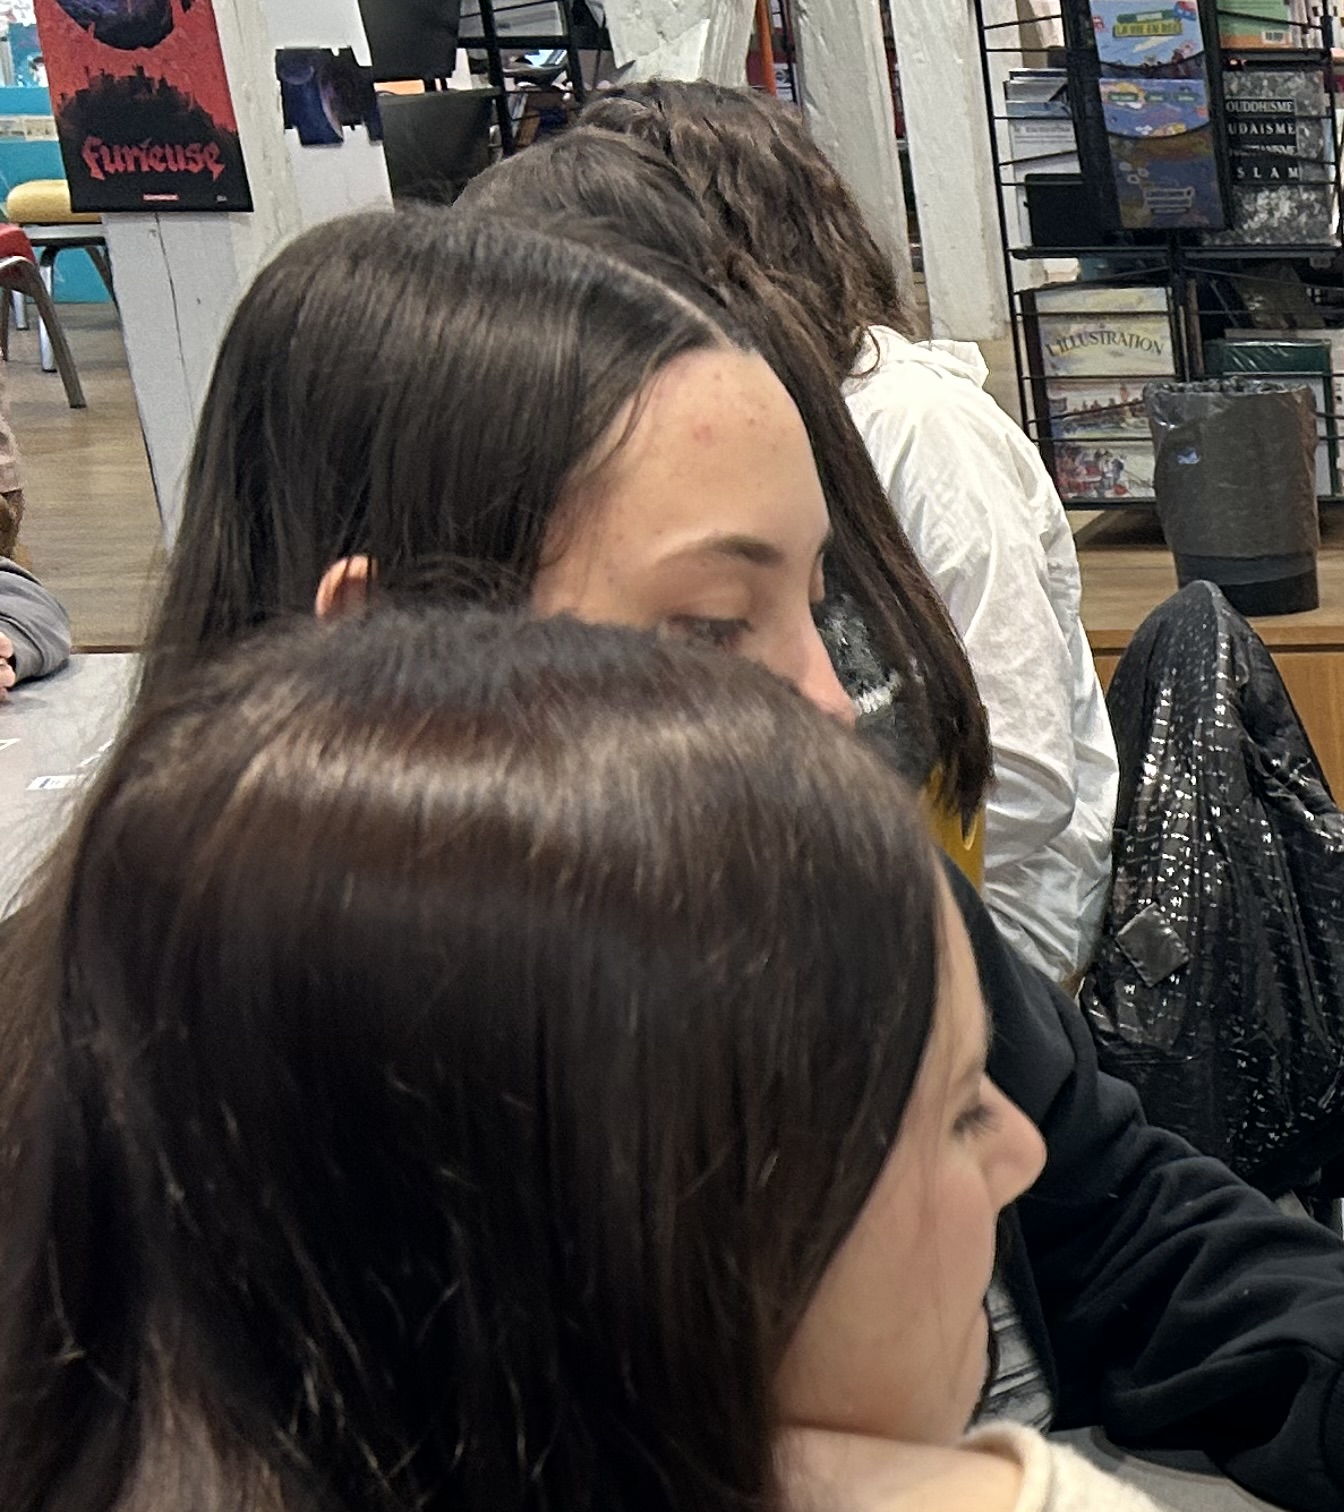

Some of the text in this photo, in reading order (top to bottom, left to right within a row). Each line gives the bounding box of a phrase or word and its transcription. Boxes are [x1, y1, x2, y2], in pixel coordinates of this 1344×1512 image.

[1225, 101, 1294, 113] OUDDHISME
[1228, 122, 1296, 135] UDAISME
[1236, 166, 1299, 179] SLAM
